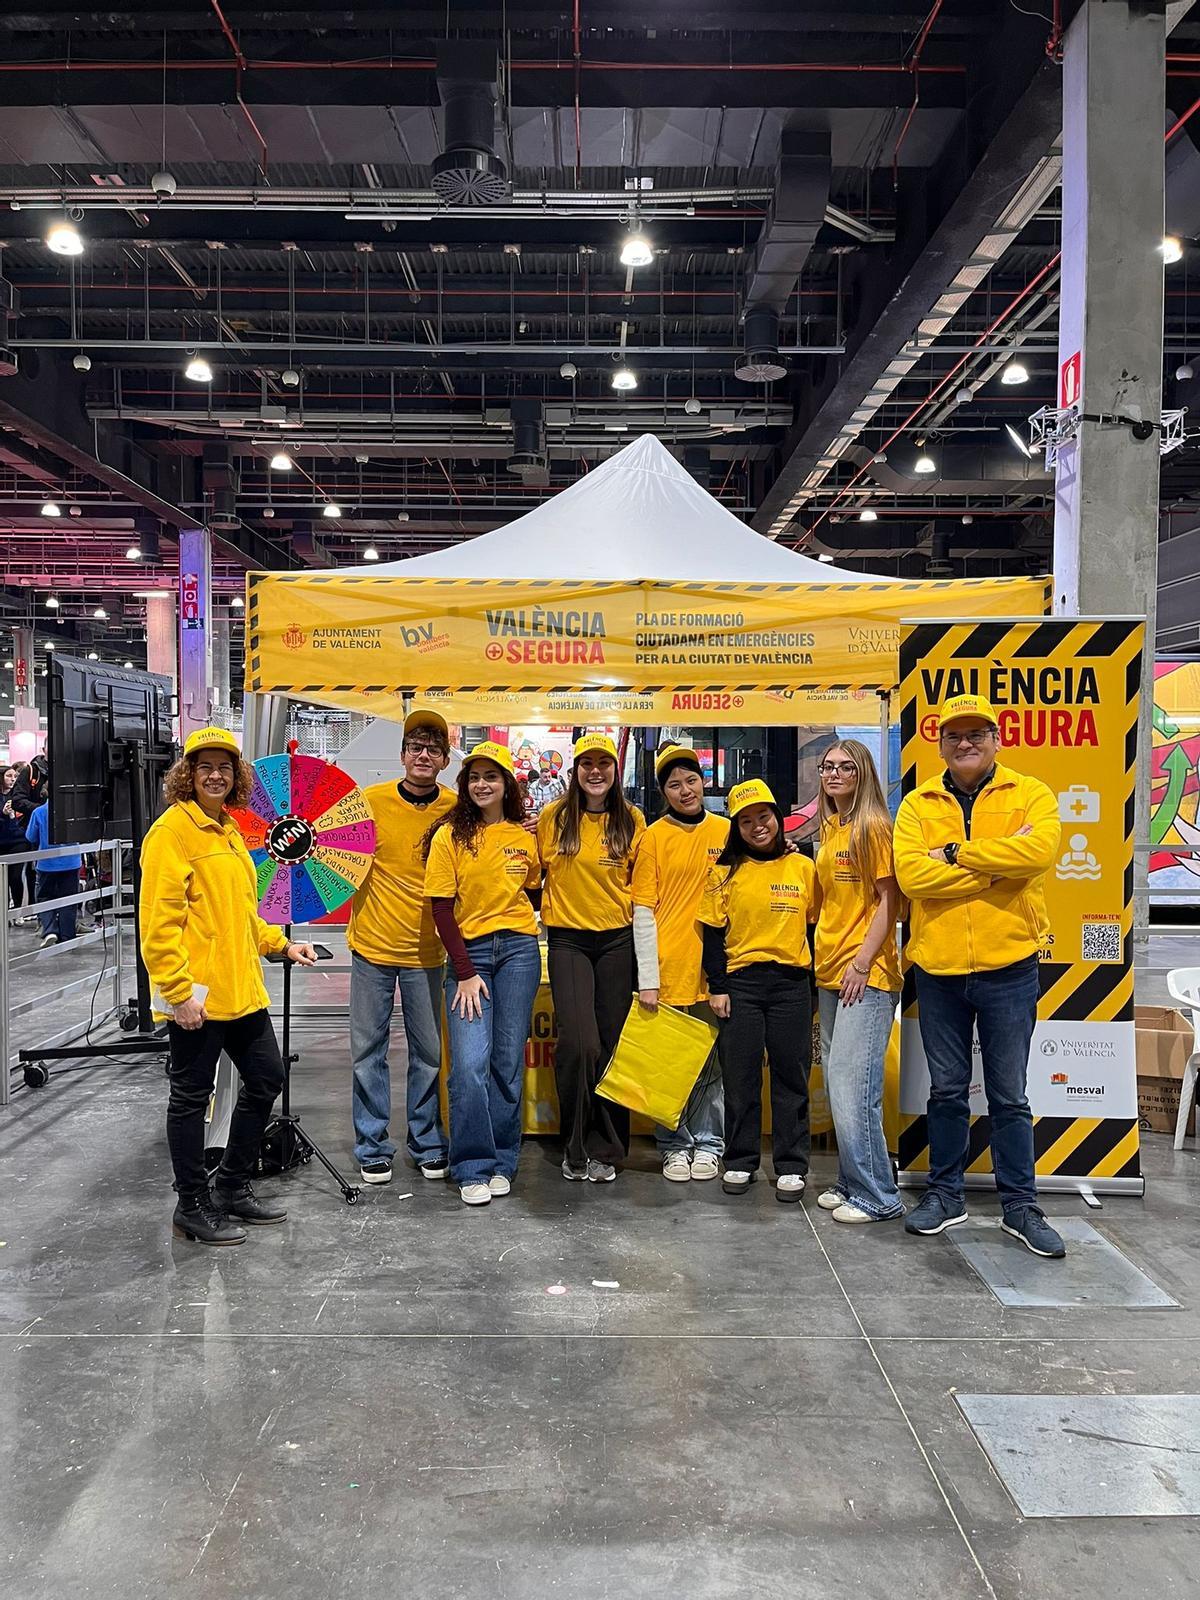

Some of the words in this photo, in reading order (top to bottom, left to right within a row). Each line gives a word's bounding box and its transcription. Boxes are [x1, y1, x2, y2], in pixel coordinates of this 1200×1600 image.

[486, 604, 606, 637] VALÈNCIA
[636, 613, 658, 626] PLA
[661, 613, 676, 626] DE
[680, 612, 744, 626] FORMACIÓ
[312, 629, 382, 638] AJUNTAMENT
[416, 632, 450, 648] bombers
[636, 633, 705, 647] CIUTADANA
[708, 634, 724, 646] EN
[728, 631, 815, 647] EMERGÈNCIES
[848, 627, 900, 640] VNIVER
[312, 640, 326, 648] DE
[330, 638, 382, 648] VALÈNCIA
[506, 640, 606, 664] SEGURA
[636, 653, 658, 664] PER
[661, 654, 669, 664] A
[672, 654, 686, 664] LA
[689, 654, 732, 664] CIUTAT
[734, 654, 750, 664] DE
[752, 651, 813, 664] VALÈNCIA
[998, 709, 1100, 748] GURA
[1066, 1086, 1104, 1094] mesval
